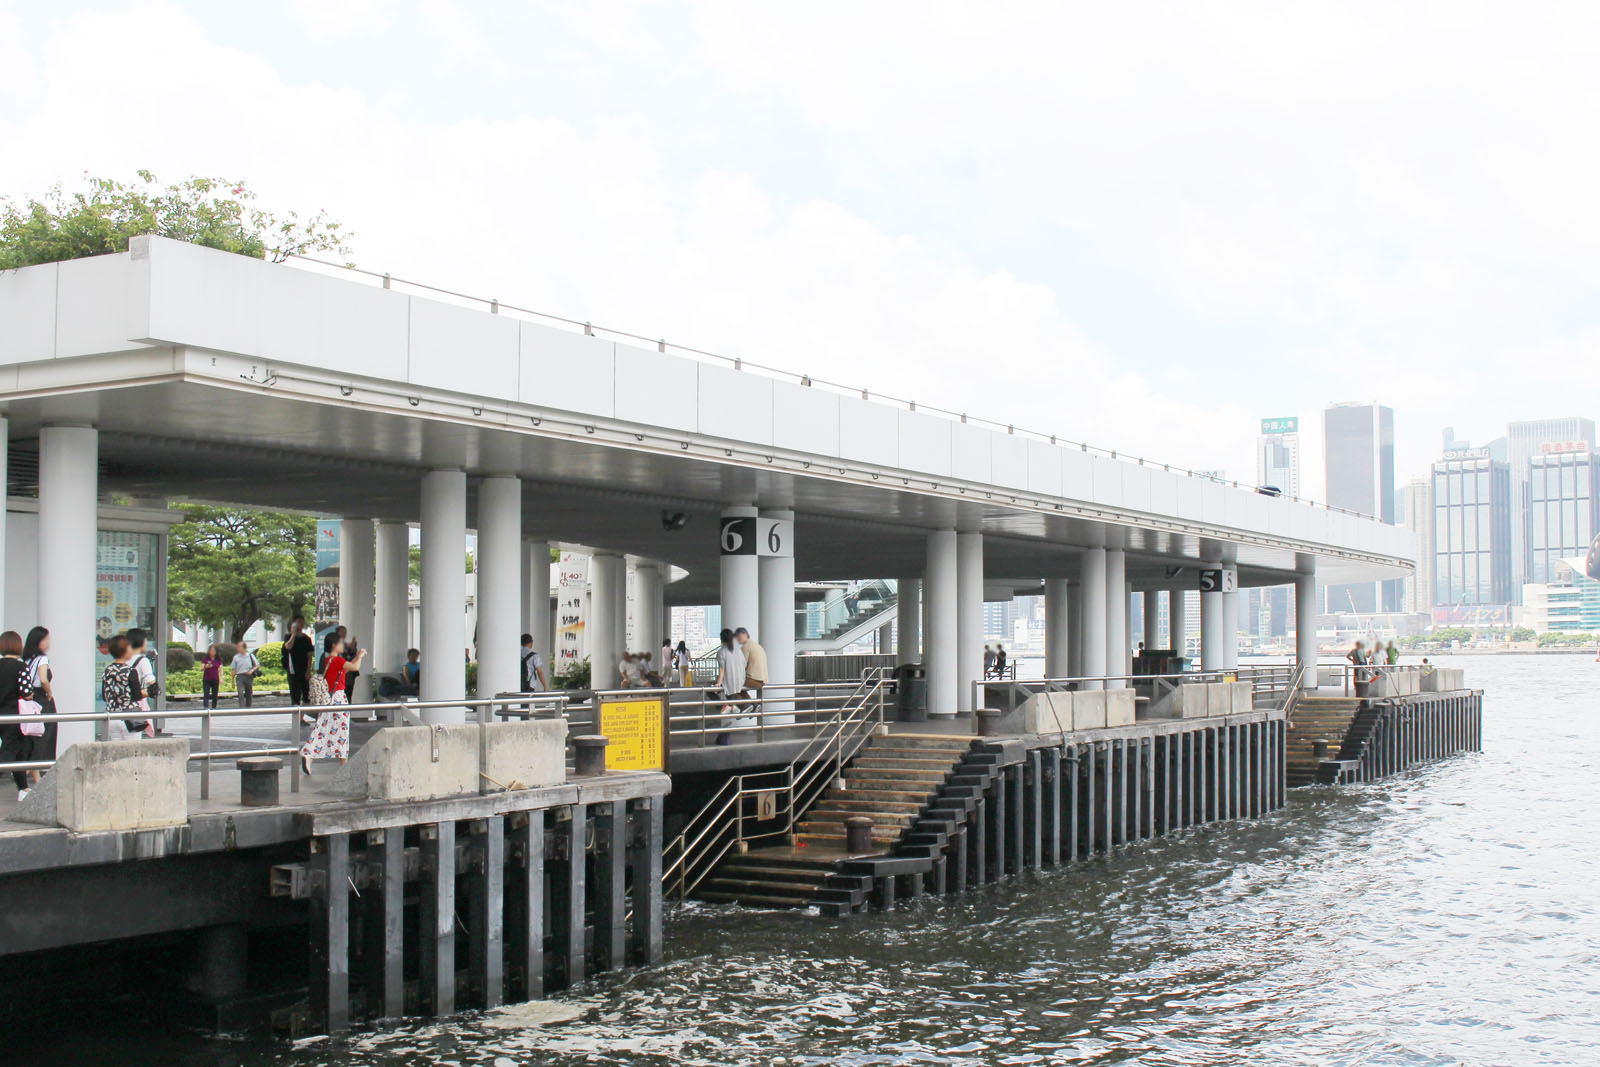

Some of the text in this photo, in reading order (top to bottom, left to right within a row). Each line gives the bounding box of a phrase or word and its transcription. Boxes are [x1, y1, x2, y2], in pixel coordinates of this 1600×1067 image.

[721, 520, 744, 552] 6
[768, 523, 781, 553] 6
[1201, 571, 1216, 591] 5
[763, 792, 772, 817] 6
